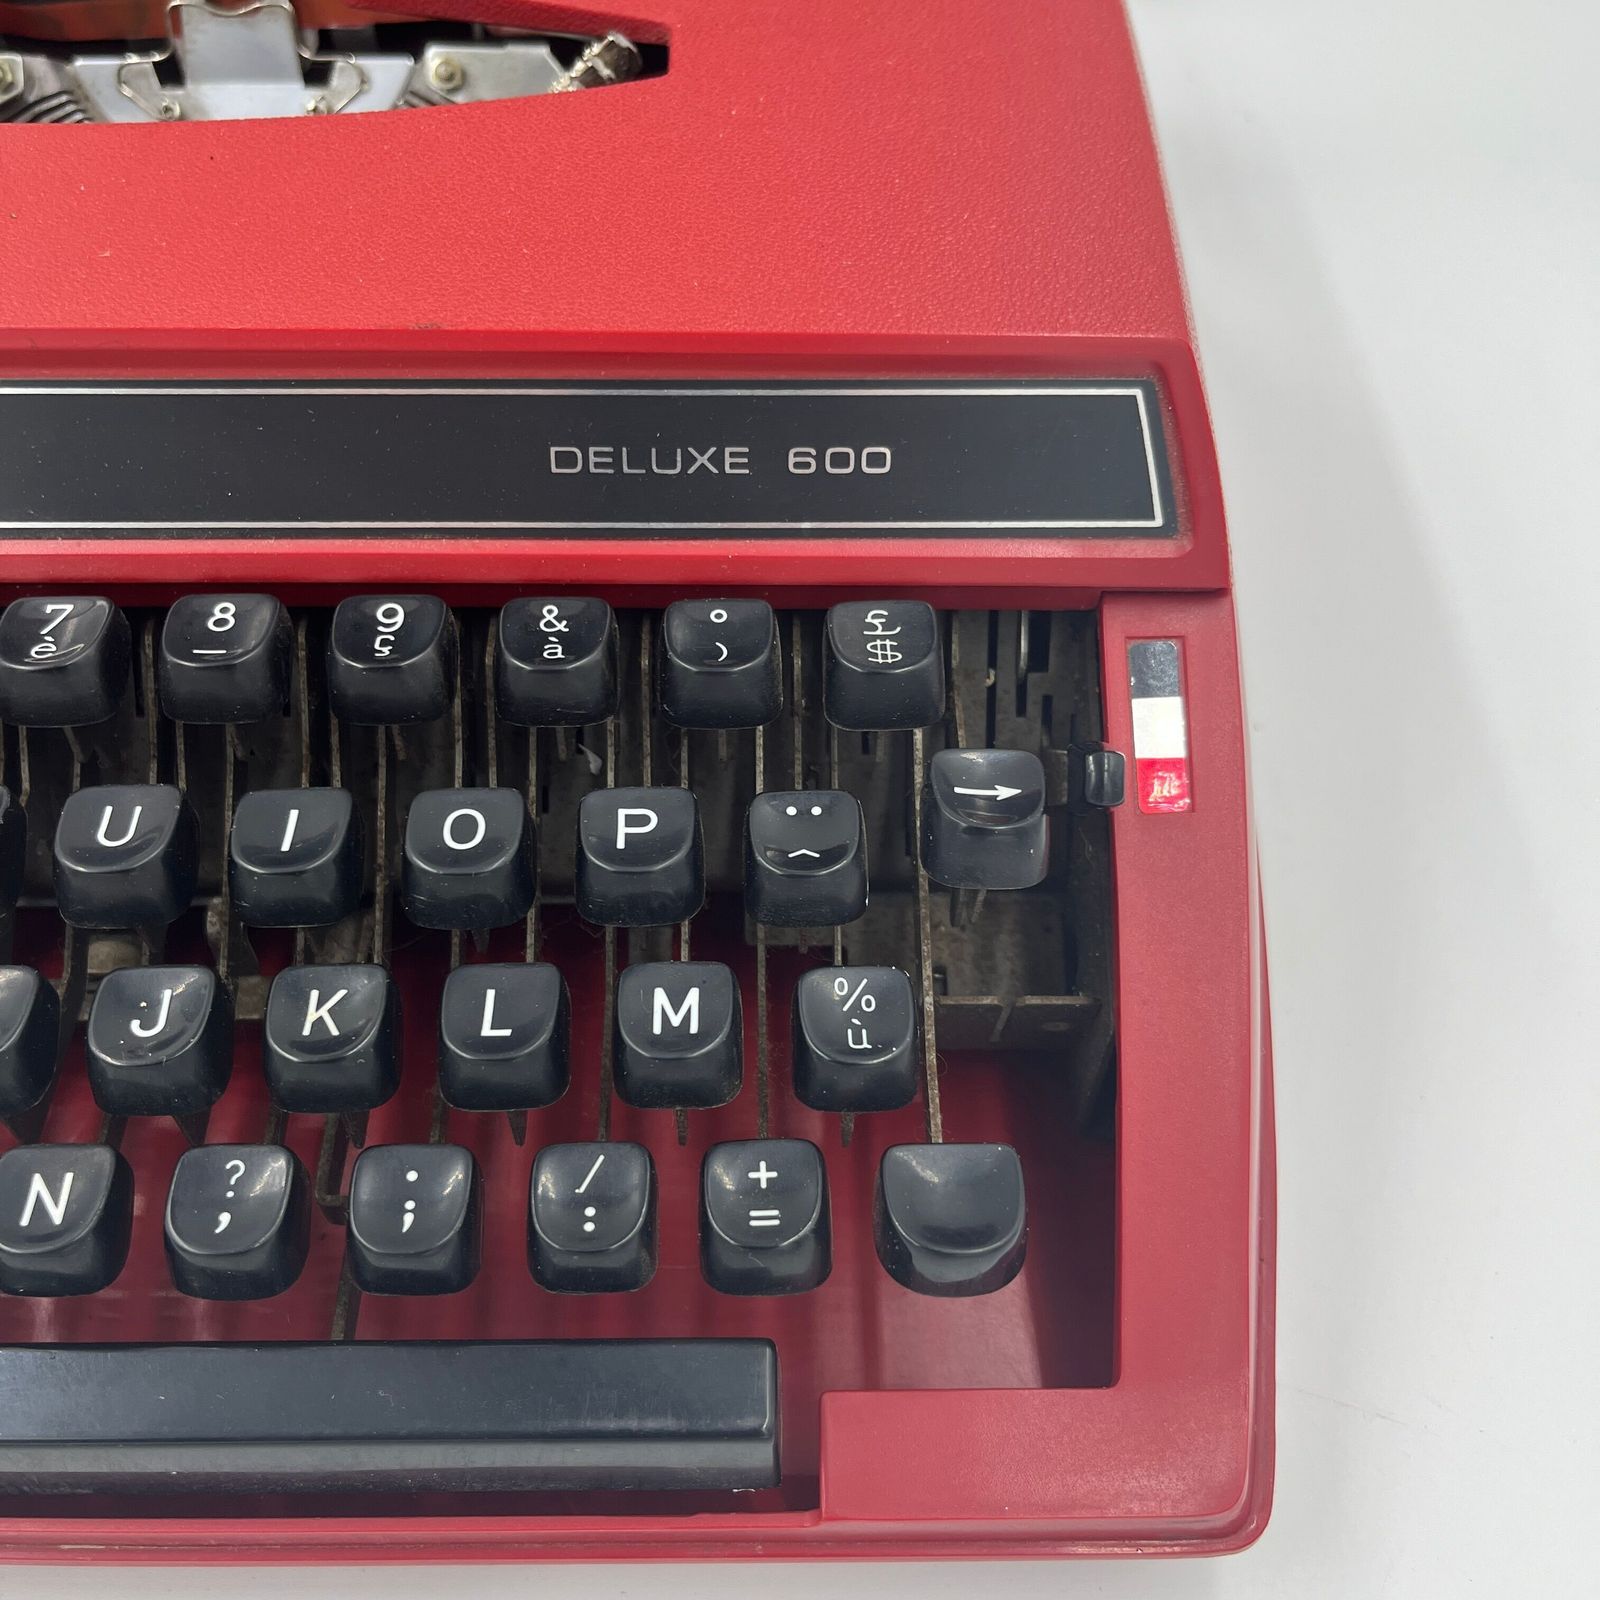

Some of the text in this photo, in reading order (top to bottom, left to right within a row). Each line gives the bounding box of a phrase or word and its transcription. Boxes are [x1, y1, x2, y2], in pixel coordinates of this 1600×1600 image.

[550, 446, 892, 475] DELUXE 600
[40, 604, 74, 635] 7
[206, 602, 237, 632] 8
[376, 602, 404, 632] 9
[539, 605, 569, 632] &
[863, 609, 901, 635] £
[373, 634, 394, 656] ç
[542, 636, 565, 659] à
[715, 642, 728, 662] )
[866, 639, 903, 664] $
[96, 805, 142, 848] U
[280, 809, 299, 852] I
[442, 808, 487, 850] O
[615, 808, 658, 850] P
[833, 976, 876, 1013] %
[129, 988, 173, 1038] J
[302, 988, 349, 1037] K
[479, 988, 513, 1037] L
[651, 986, 700, 1036] M
[846, 1018, 872, 1050] ù
[224, 1159, 247, 1198] ?
[574, 1154, 605, 1194] /
[747, 1160, 779, 1190] +
[18, 1171, 74, 1228] N
[213, 1211, 232, 1234] ,
[401, 1199, 416, 1234] ;
[748, 1208, 782, 1227] =
